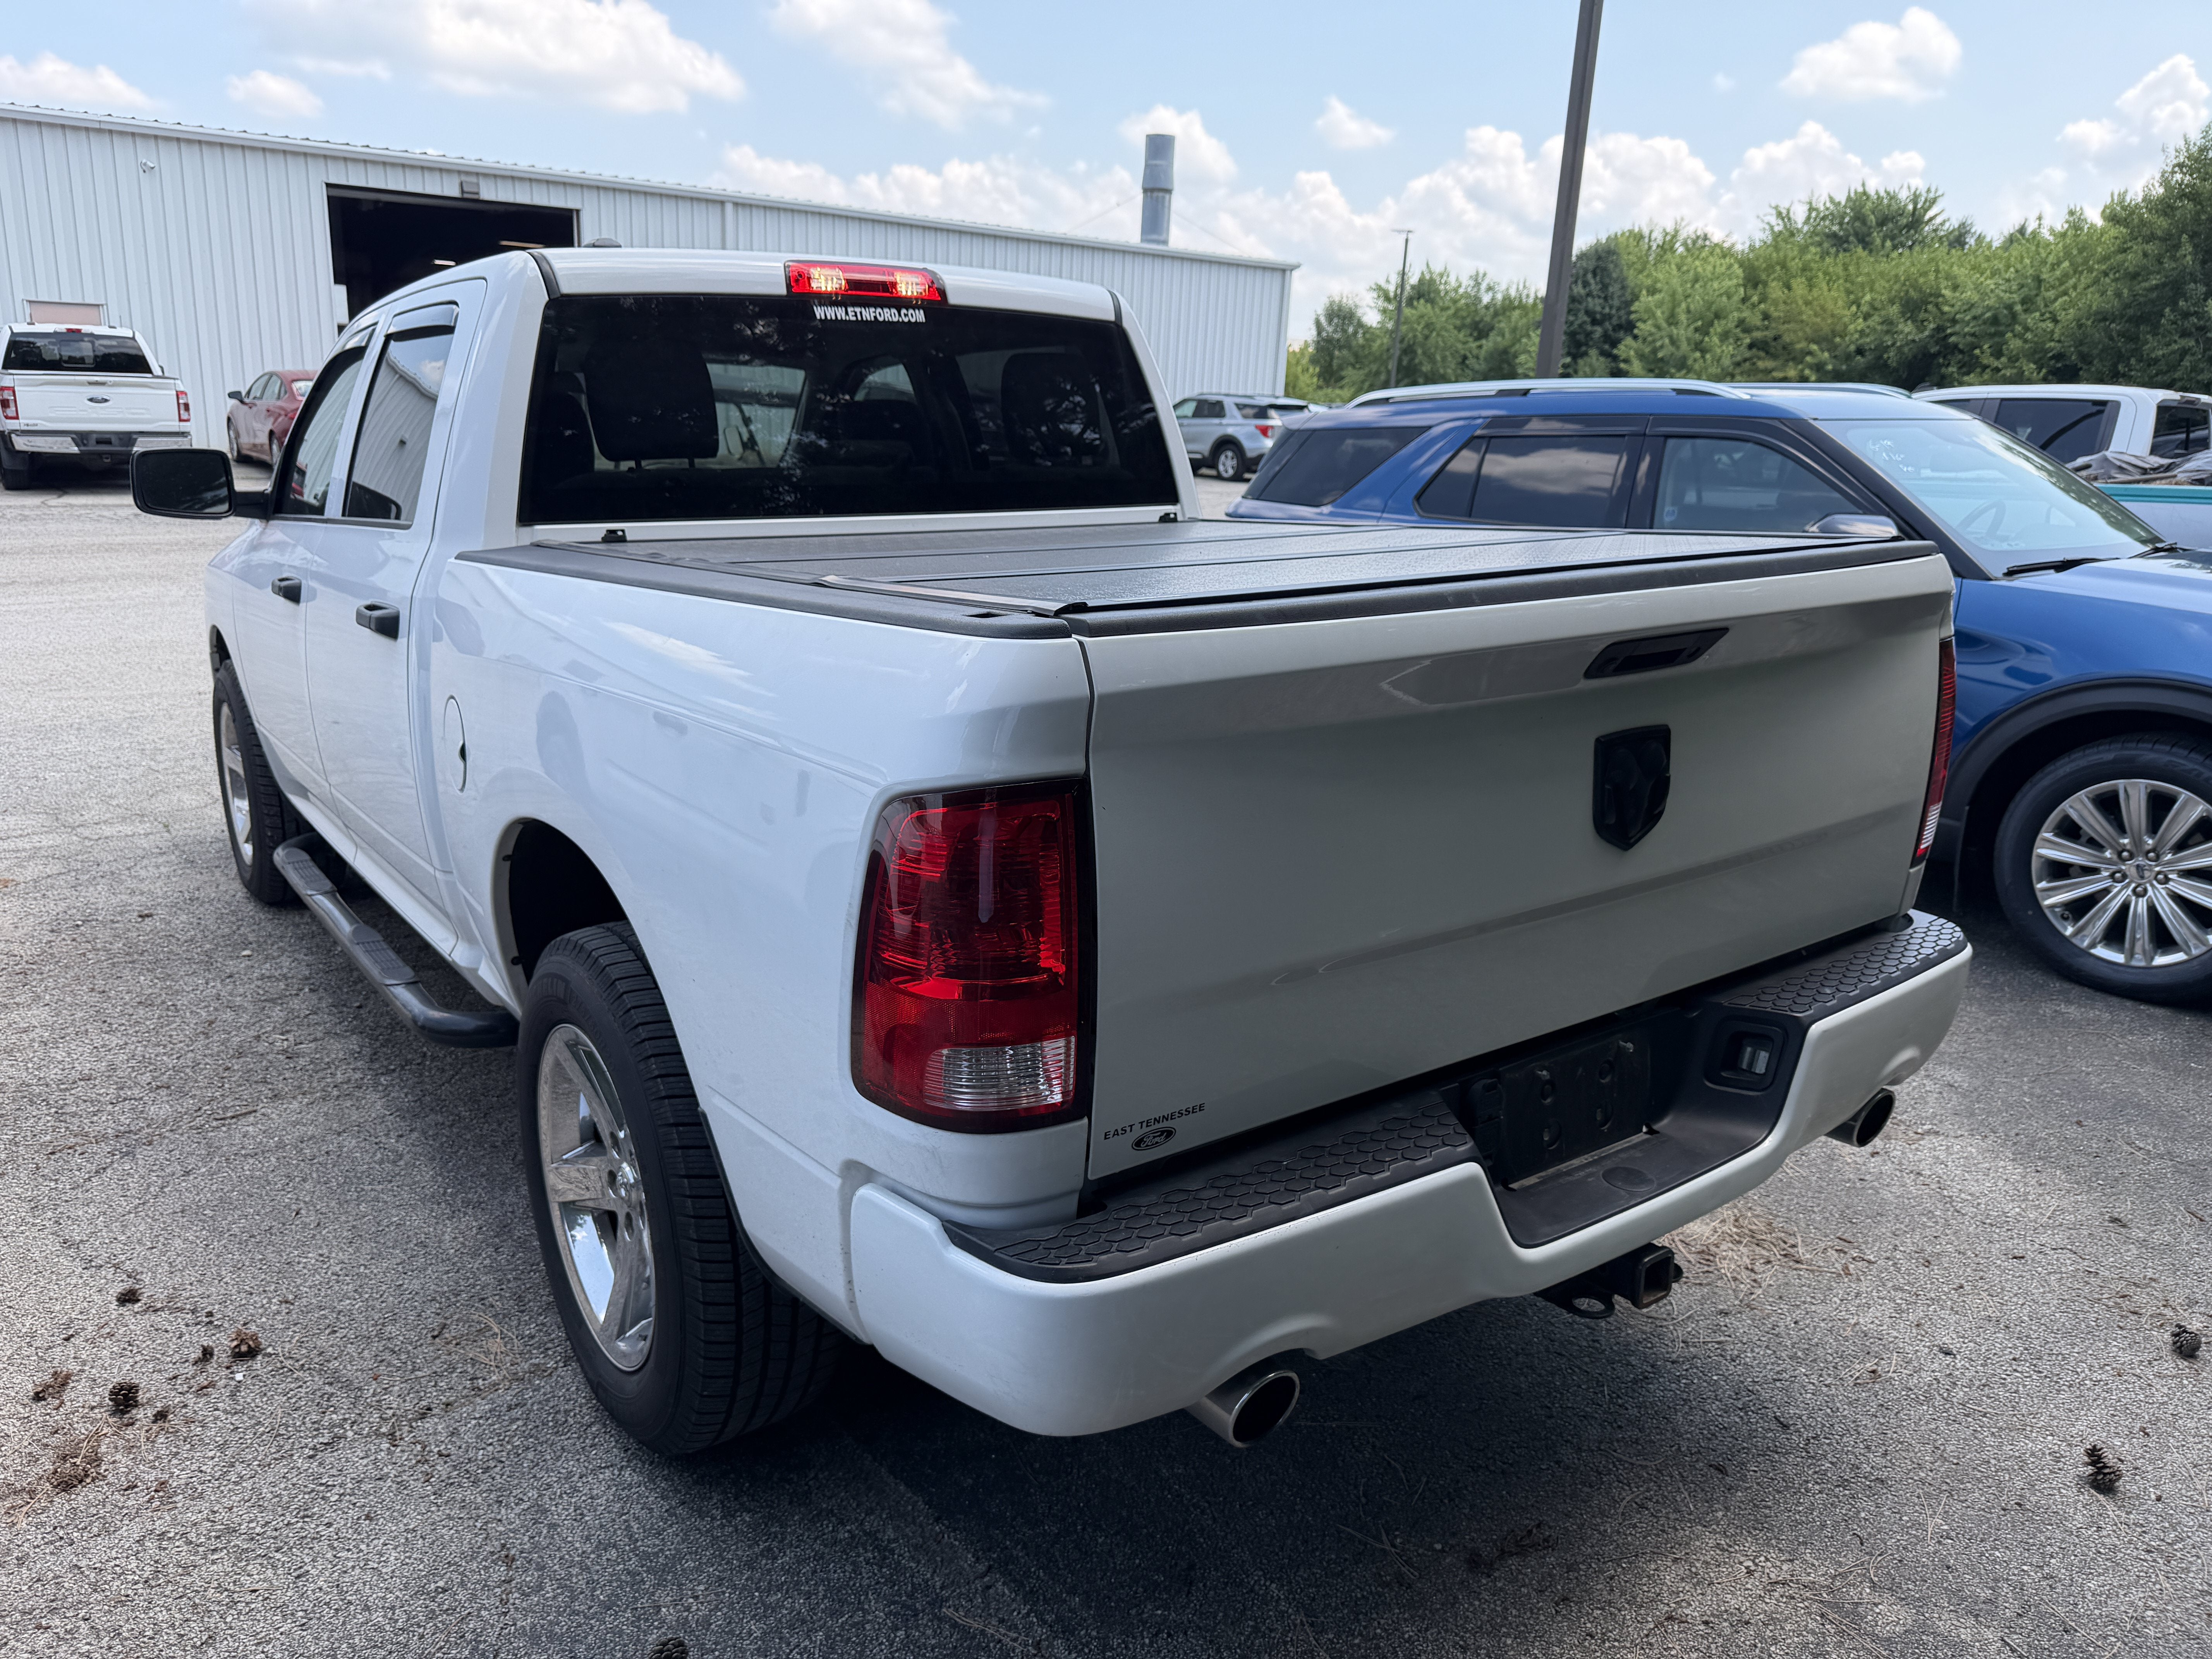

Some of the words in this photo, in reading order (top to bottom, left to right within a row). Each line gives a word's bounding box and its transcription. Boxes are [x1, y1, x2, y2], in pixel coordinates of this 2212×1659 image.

[813, 304, 926, 323] WWW.ETNFORD.COM
[1104, 1123, 1135, 1140] EAST
[1138, 1103, 1205, 1129] TENNESSEE
